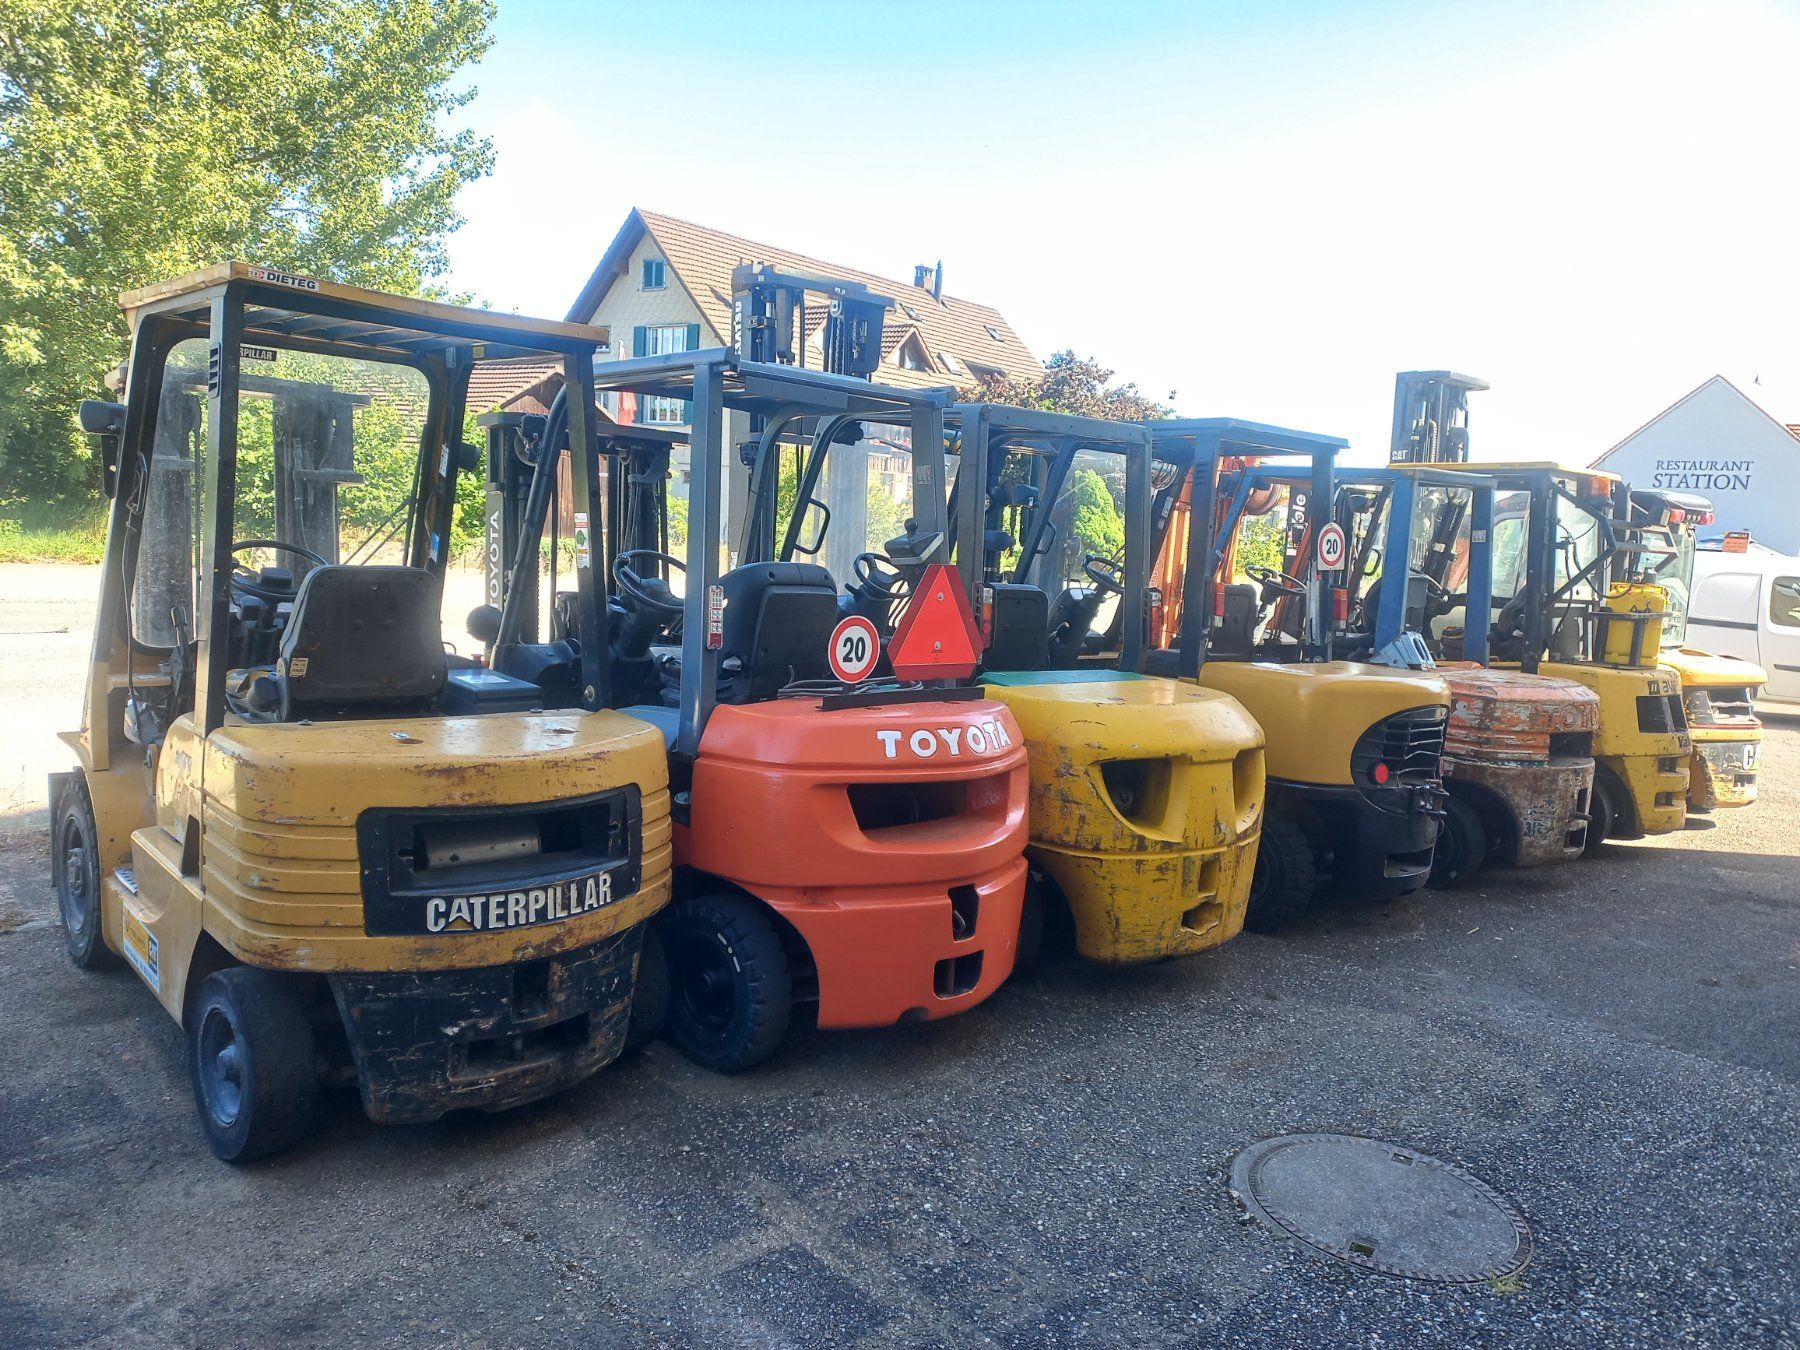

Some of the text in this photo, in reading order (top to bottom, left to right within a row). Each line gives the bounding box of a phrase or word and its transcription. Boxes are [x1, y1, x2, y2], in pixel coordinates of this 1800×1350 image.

[266, 272, 316, 290] DIETEG
[733, 301, 742, 355] MATSU
[240, 347, 273, 360] RPILLAR
[1391, 449, 1409, 461] CAT
[1656, 460, 1754, 472] RESTAURANT
[1652, 473, 1752, 490] STATION
[1326, 538, 1338, 555] 20
[842, 636, 866, 663] 20
[876, 720, 1012, 758] TOYOTA
[426, 870, 612, 932] CATERPILLAR
